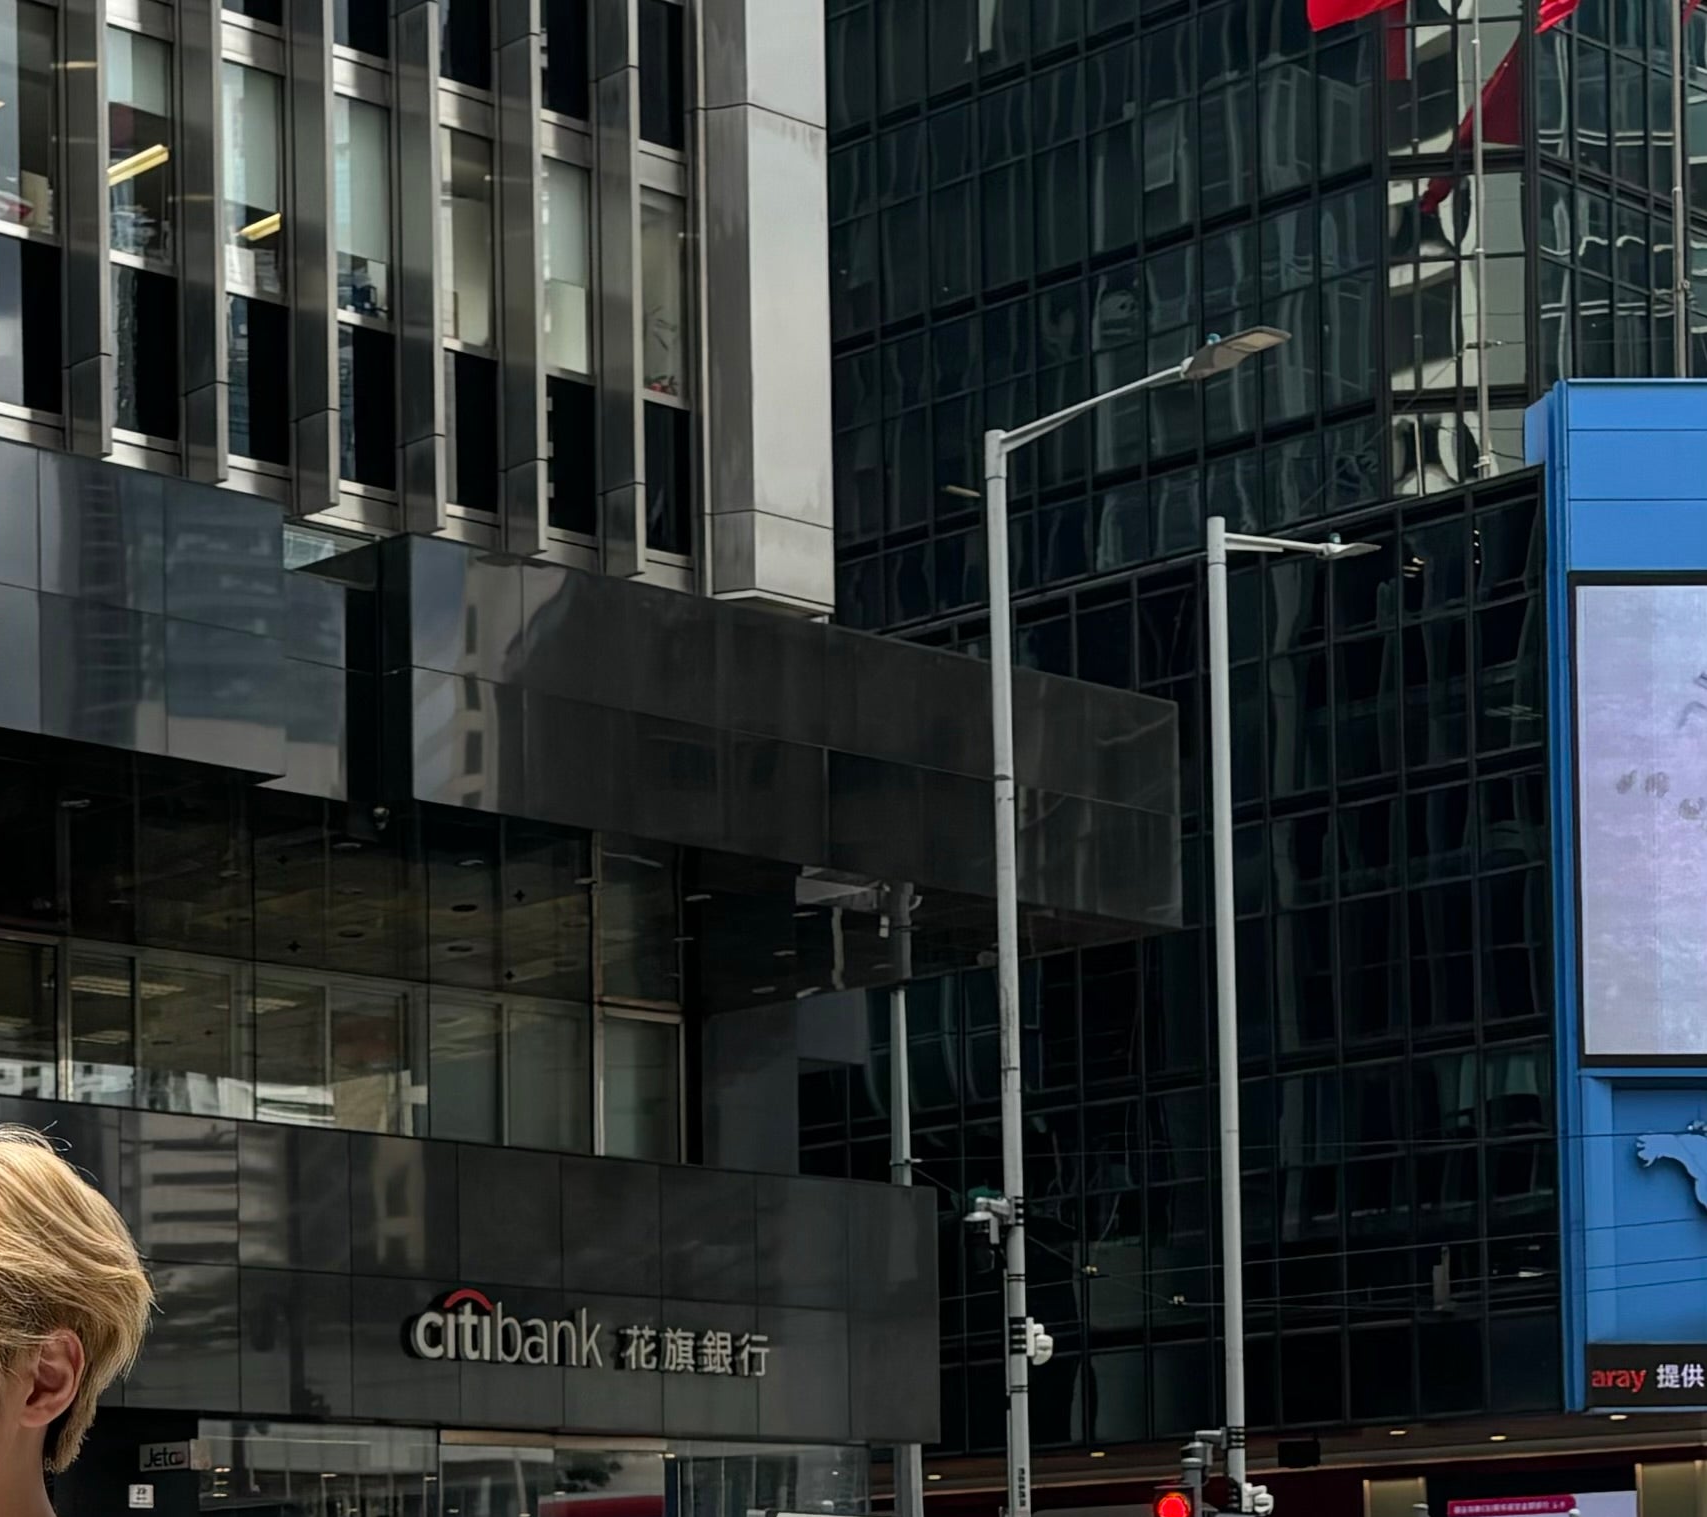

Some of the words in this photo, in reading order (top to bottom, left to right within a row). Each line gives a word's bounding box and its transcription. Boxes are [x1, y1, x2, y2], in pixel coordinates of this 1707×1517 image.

[414, 1296, 603, 1368] citibank
[615, 1324, 771, 1377] 花旗銀行
[1656, 1363, 1705, 1389] 提供
